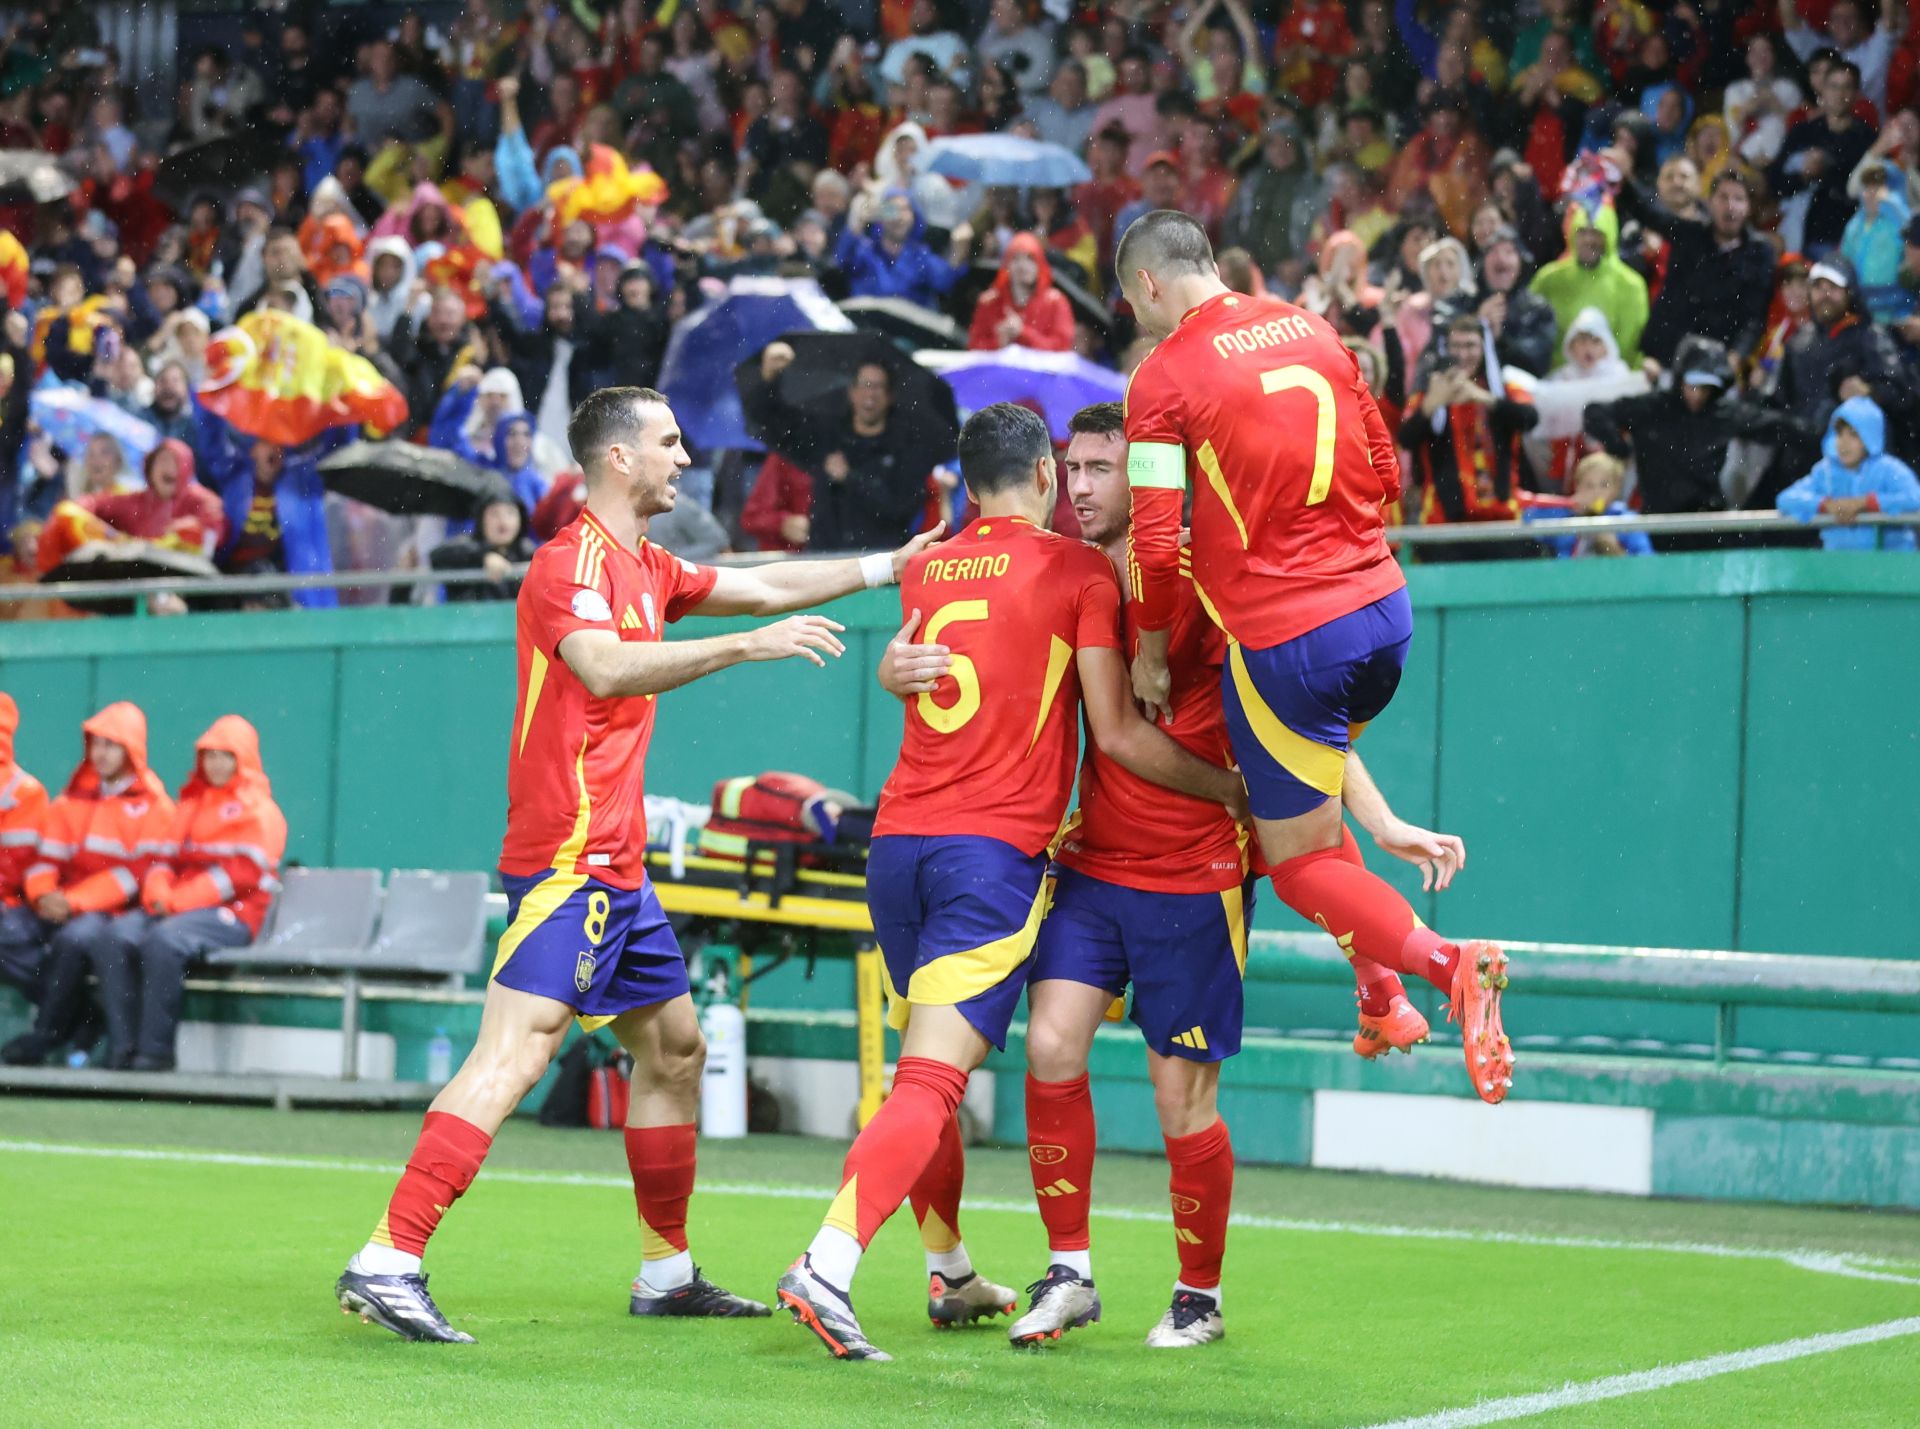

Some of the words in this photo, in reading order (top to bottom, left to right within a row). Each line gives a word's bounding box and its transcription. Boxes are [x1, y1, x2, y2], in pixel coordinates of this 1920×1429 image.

[1212, 315, 1315, 359] MORATA
[1260, 364, 1337, 507] 7
[922, 553, 1010, 585] MERINO
[917, 599, 990, 735] 6
[584, 891, 610, 945] 8
